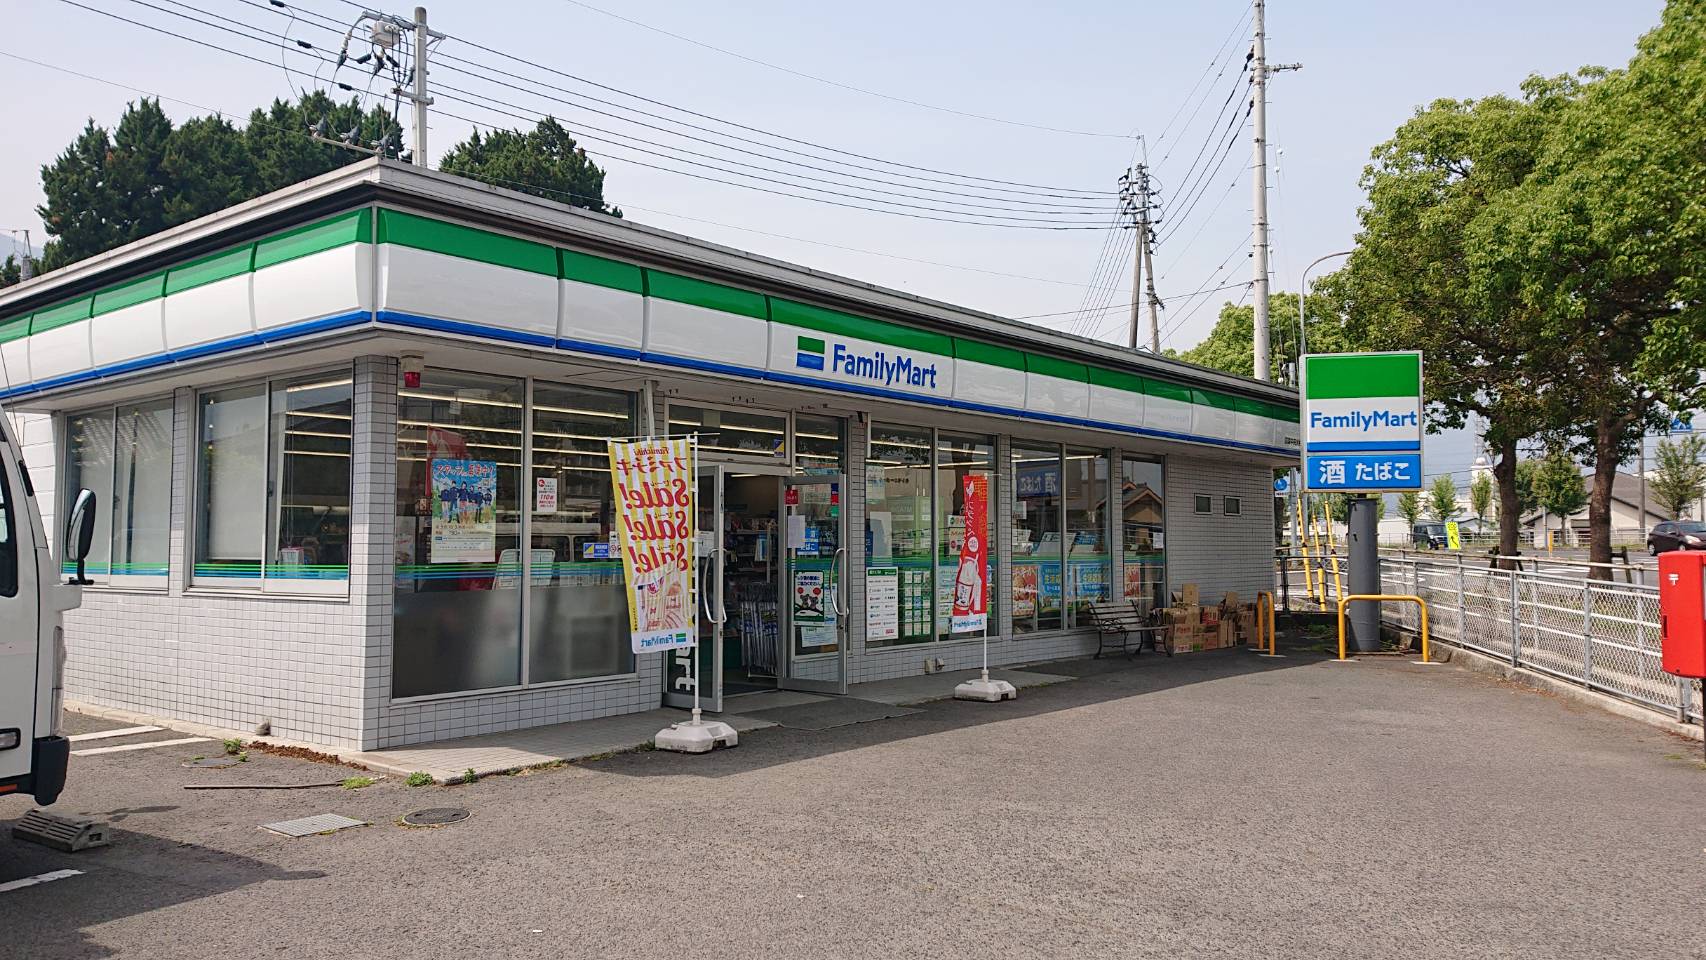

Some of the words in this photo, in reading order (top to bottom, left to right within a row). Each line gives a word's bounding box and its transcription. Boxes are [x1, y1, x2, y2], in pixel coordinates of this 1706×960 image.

[832, 343, 937, 388] FamilyMart
[1310, 410, 1418, 432] FamilyMart
[1319, 460, 1346, 484] 酒
[1355, 461, 1411, 481] たばこ
